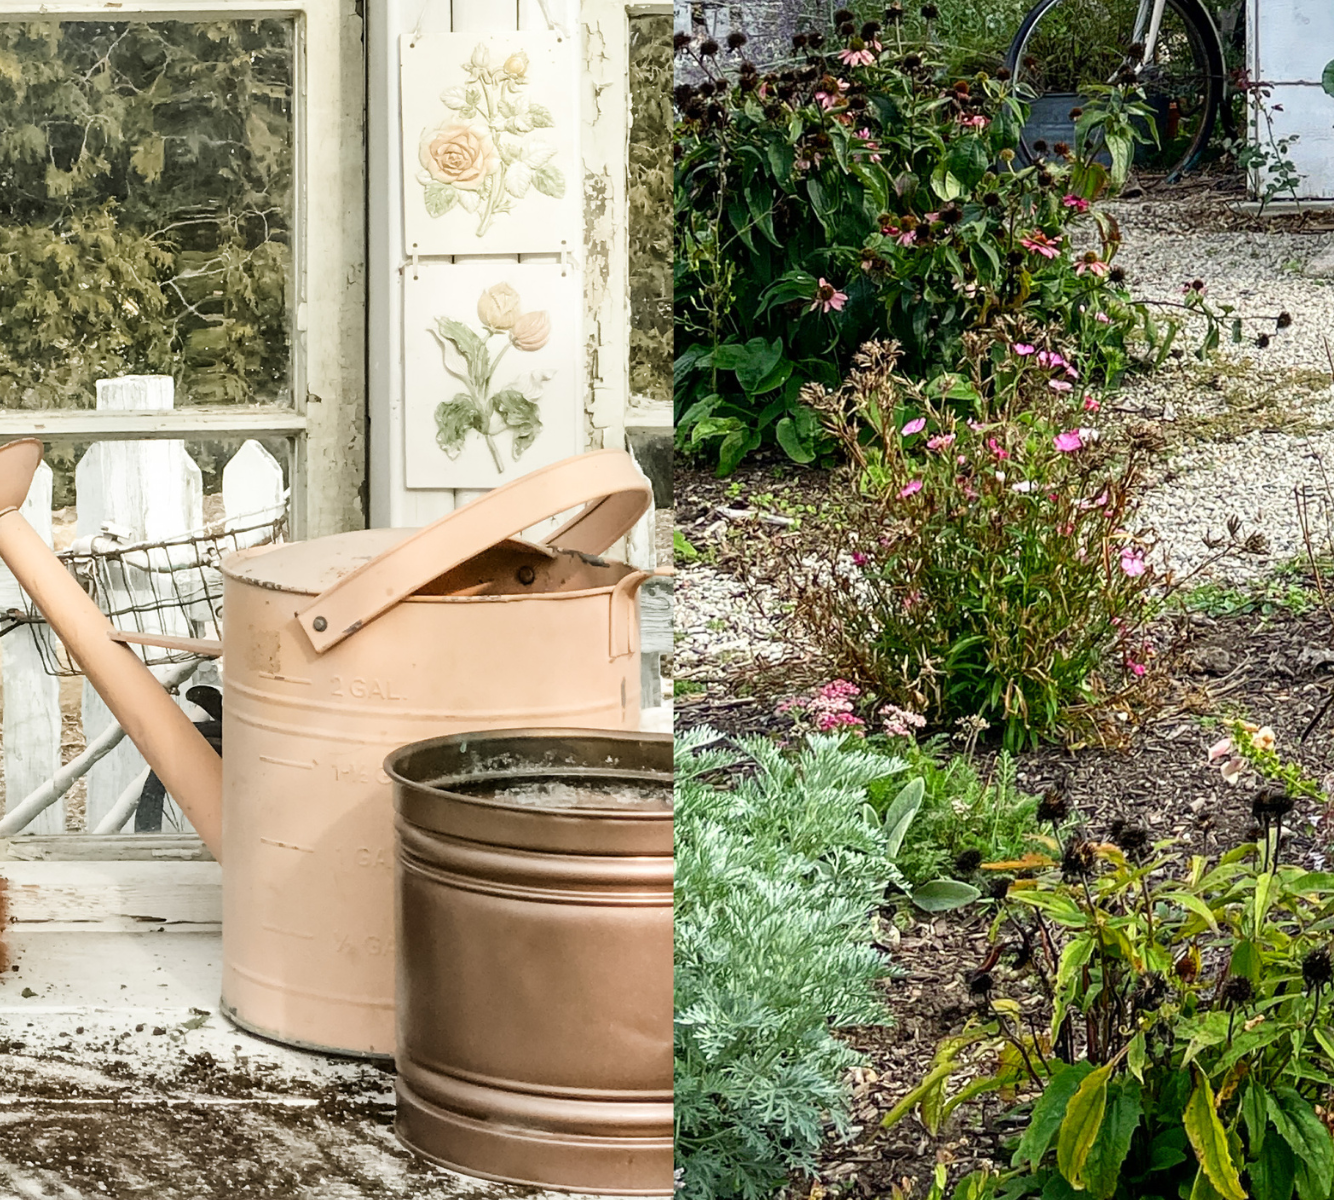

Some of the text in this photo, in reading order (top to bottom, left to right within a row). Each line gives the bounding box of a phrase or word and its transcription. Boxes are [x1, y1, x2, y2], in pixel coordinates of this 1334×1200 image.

[330, 674, 408, 701] 2 GAL.
[353, 845, 393, 870] GA
